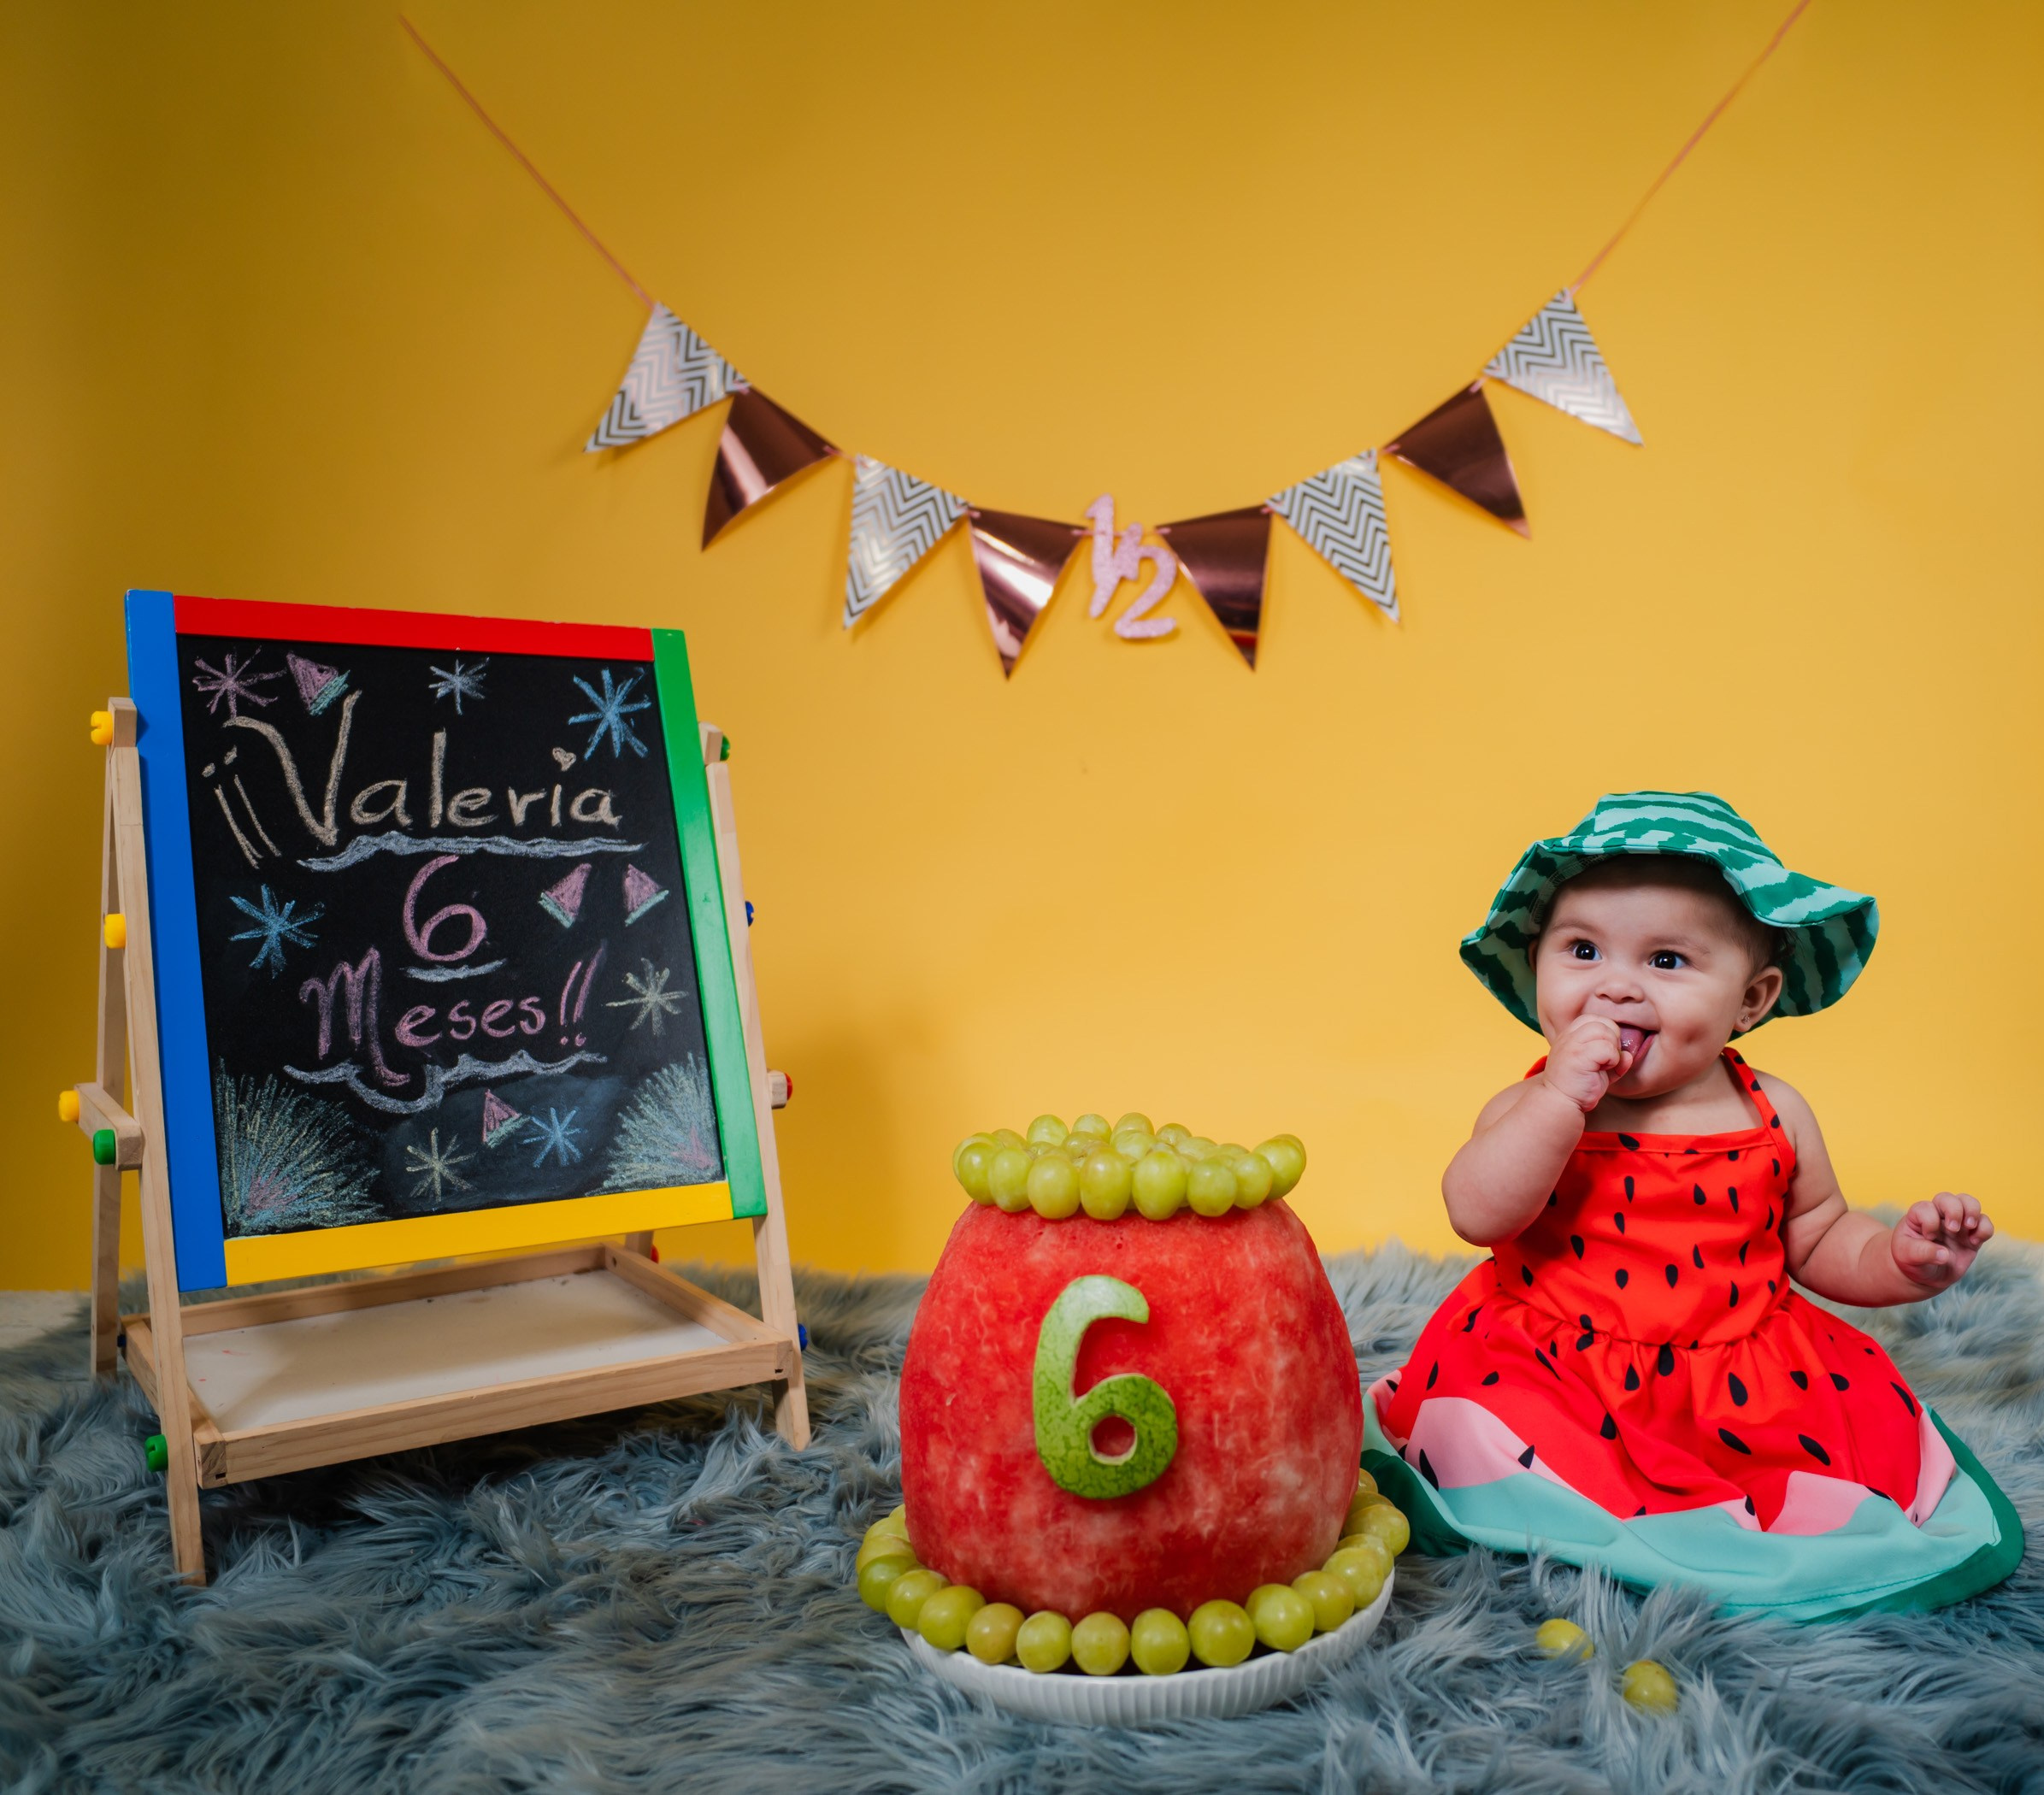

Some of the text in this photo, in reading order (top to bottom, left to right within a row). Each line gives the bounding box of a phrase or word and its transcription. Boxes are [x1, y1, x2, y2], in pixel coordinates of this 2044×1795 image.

[403, 855, 487, 962] 6
[298, 945, 604, 1086] Meses!!
[1032, 1274, 1179, 1500] 6
